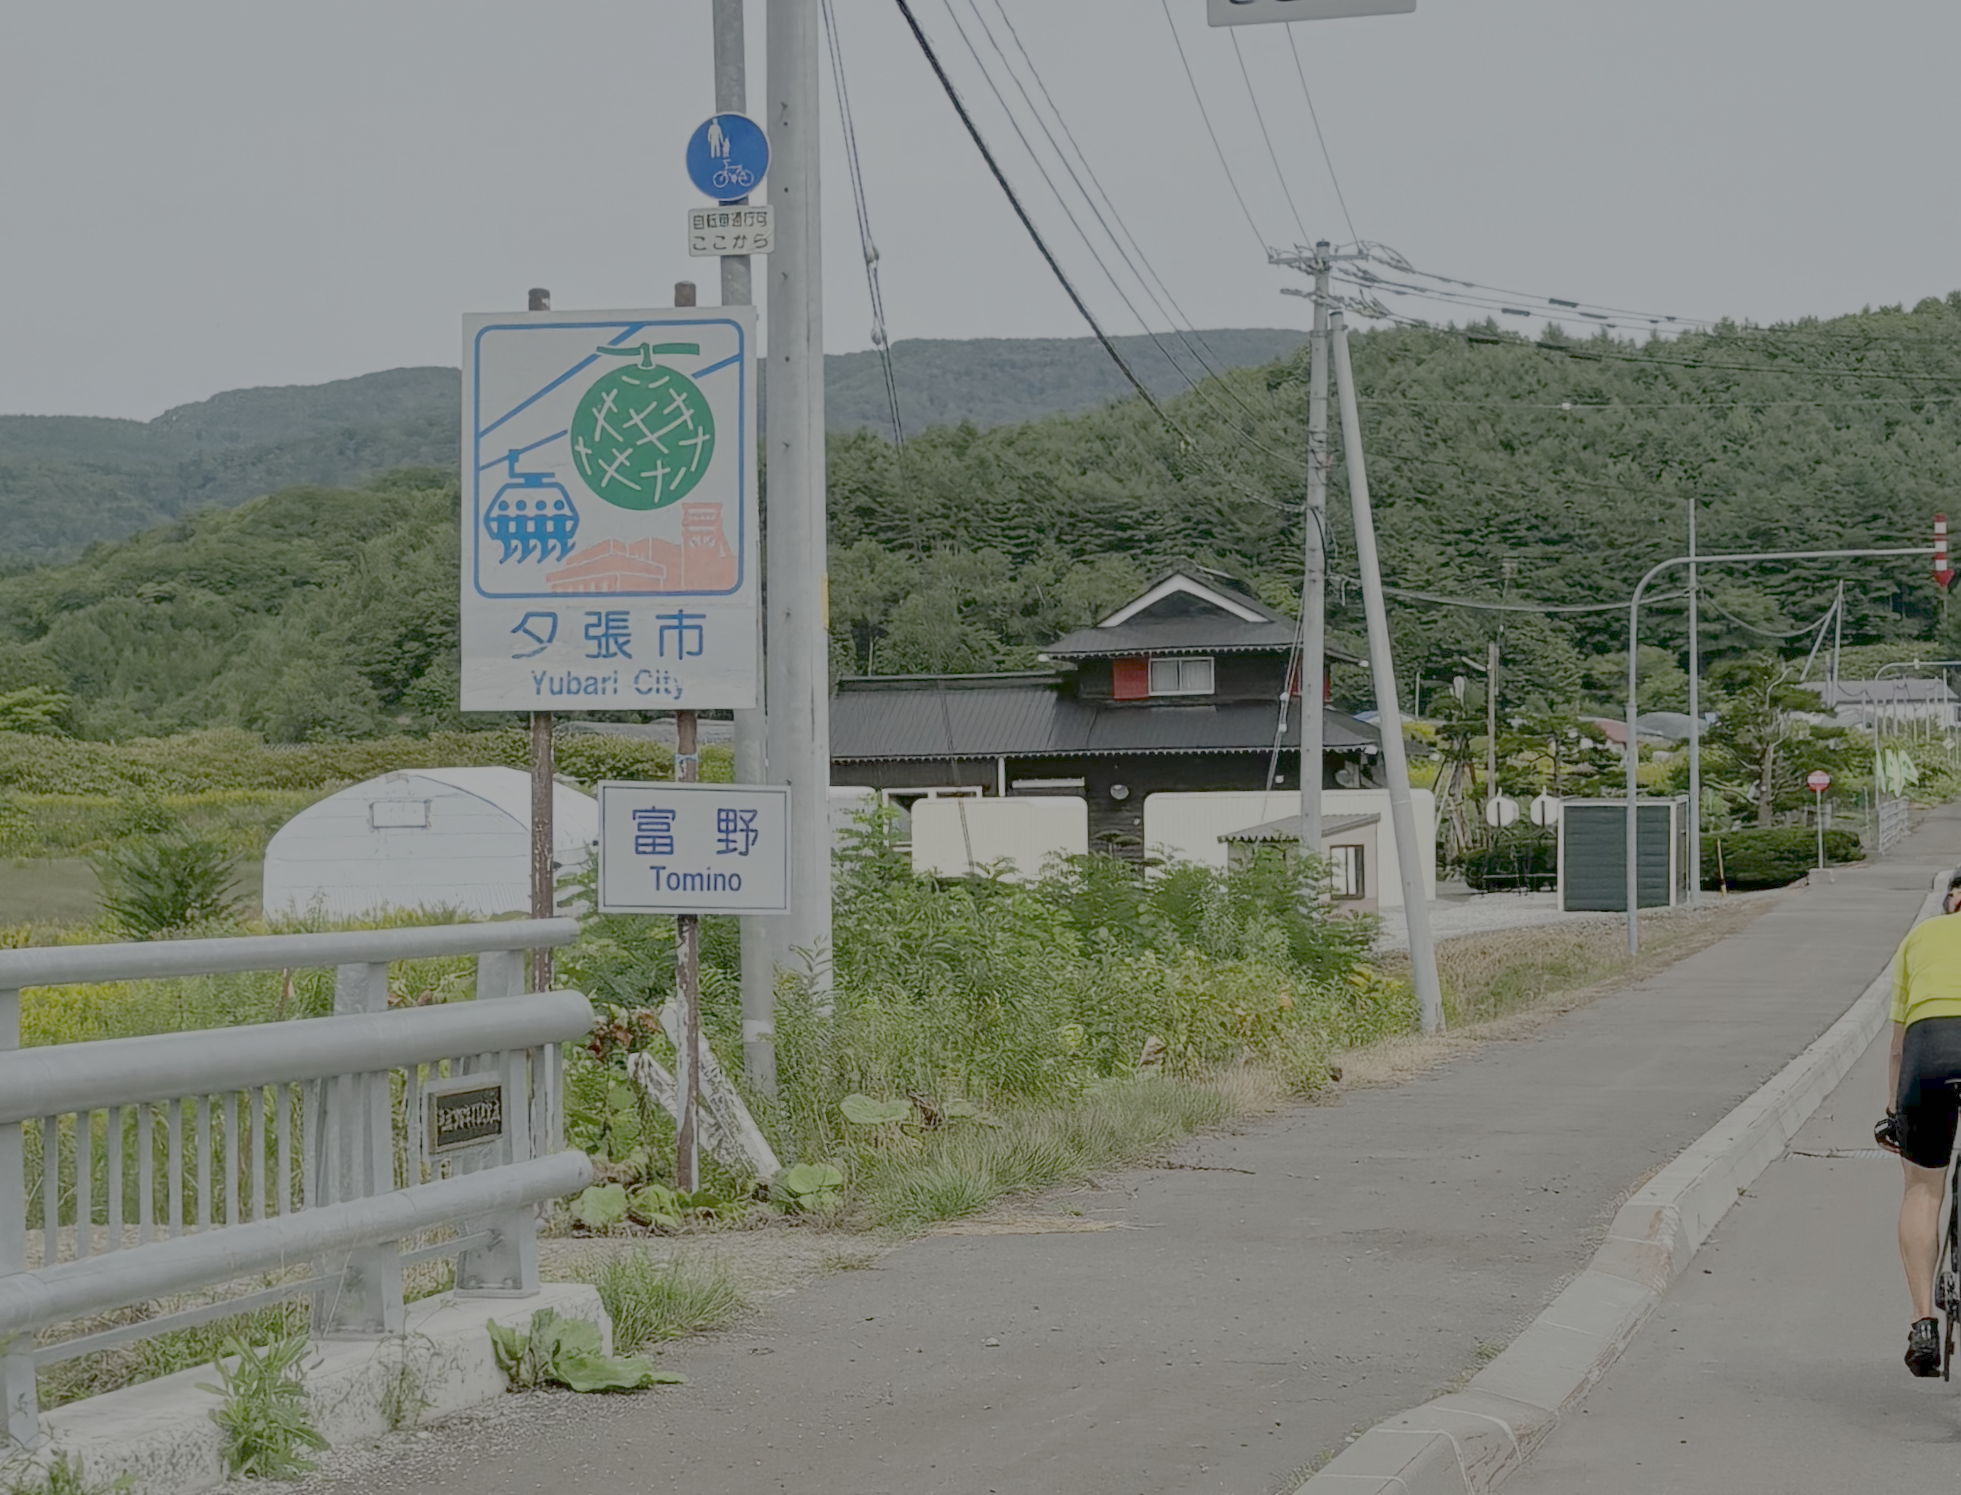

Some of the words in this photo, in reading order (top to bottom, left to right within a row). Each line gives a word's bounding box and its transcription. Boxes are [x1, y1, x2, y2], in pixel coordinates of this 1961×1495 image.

[693, 233, 769, 251] ここから
[510, 608, 707, 660] 夕張市
[532, 669, 619, 696] Yubari
[633, 668, 684, 701] City
[632, 805, 759, 857] 富野
[650, 865, 743, 892] Tomino
